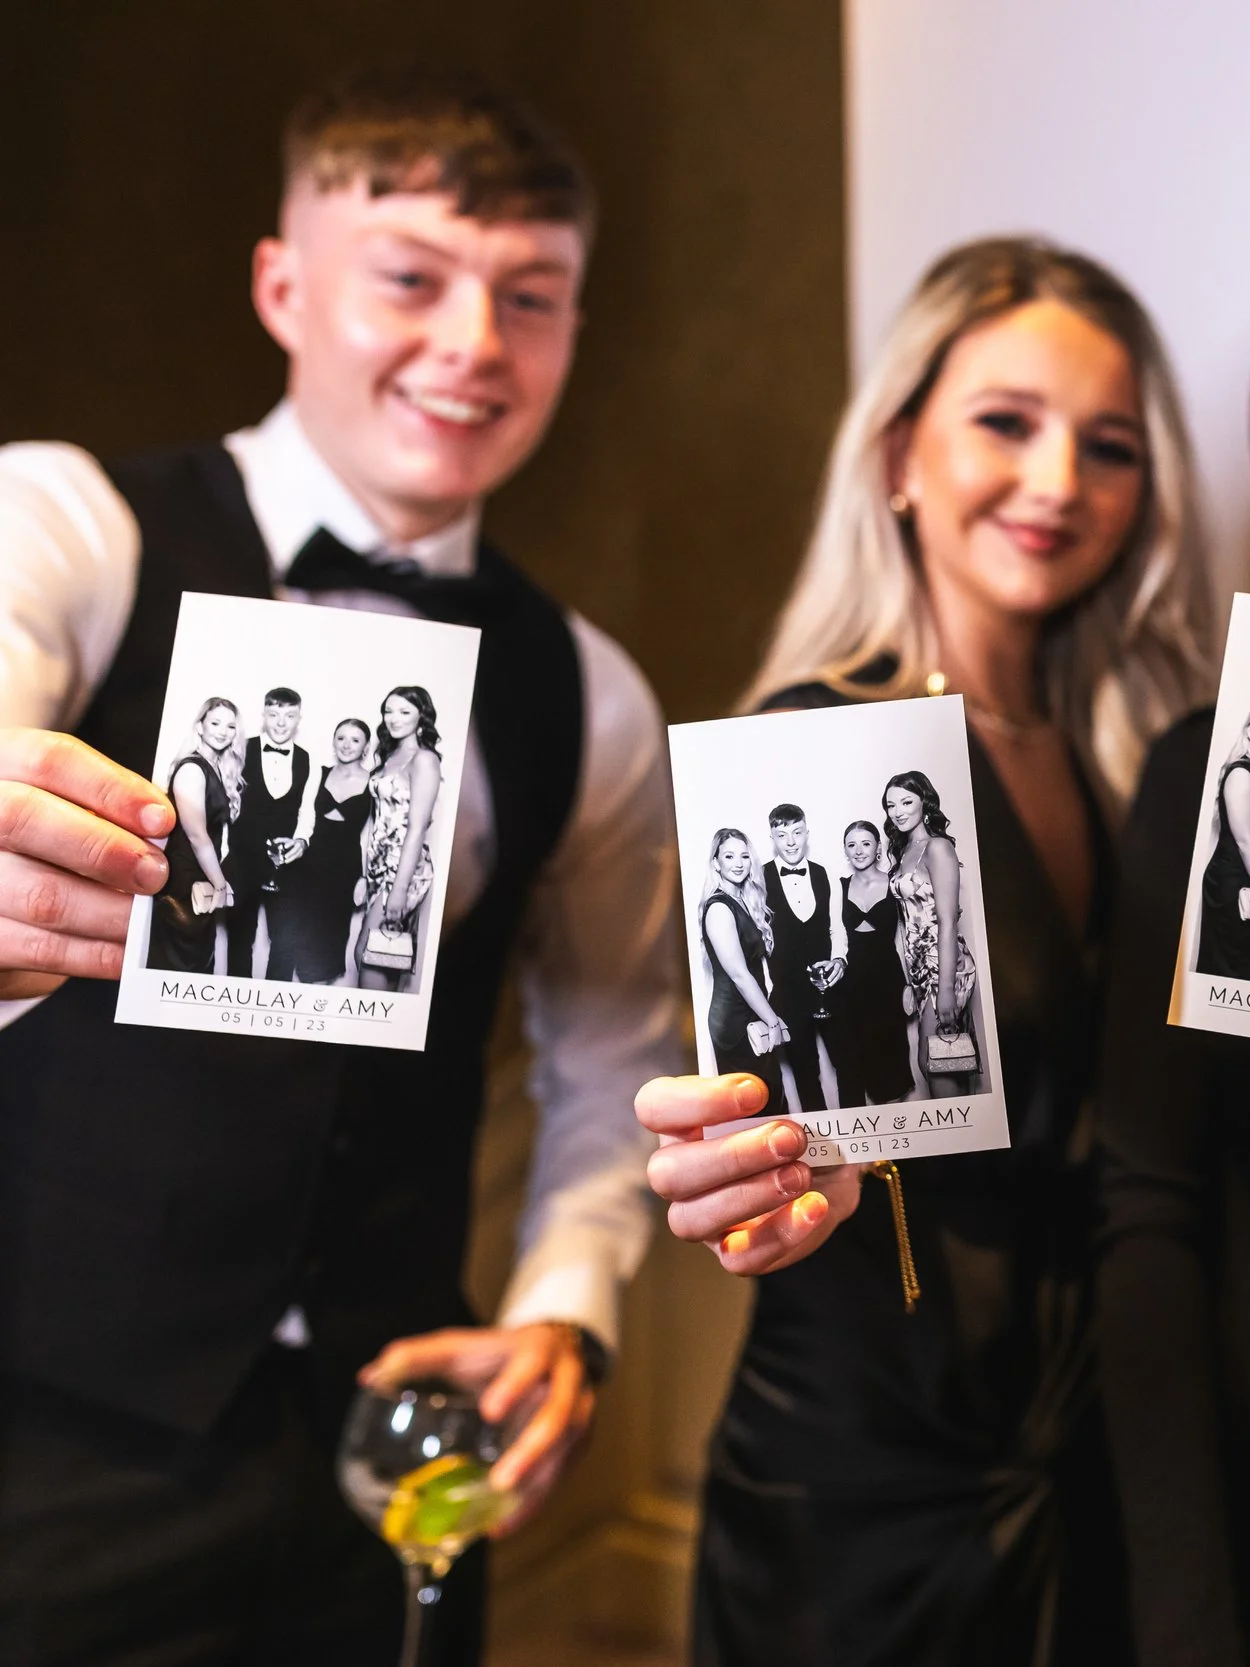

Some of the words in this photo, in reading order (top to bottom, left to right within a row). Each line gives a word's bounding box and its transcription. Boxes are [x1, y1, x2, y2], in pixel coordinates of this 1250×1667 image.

[160, 981, 303, 1010] MACAULAY
[313, 998, 329, 1012] &
[338, 998, 395, 1019] AMY
[221, 1012, 241, 1024] 05
[264, 1015, 284, 1028] 05
[306, 1019, 326, 1032] 23
[802, 1115, 881, 1139] AULAY
[893, 1115, 908, 1130] &
[917, 1106, 972, 1129] AMY
[808, 1145, 828, 1157] 05
[849, 1141, 870, 1154] 05
[891, 1137, 911, 1151] 23
